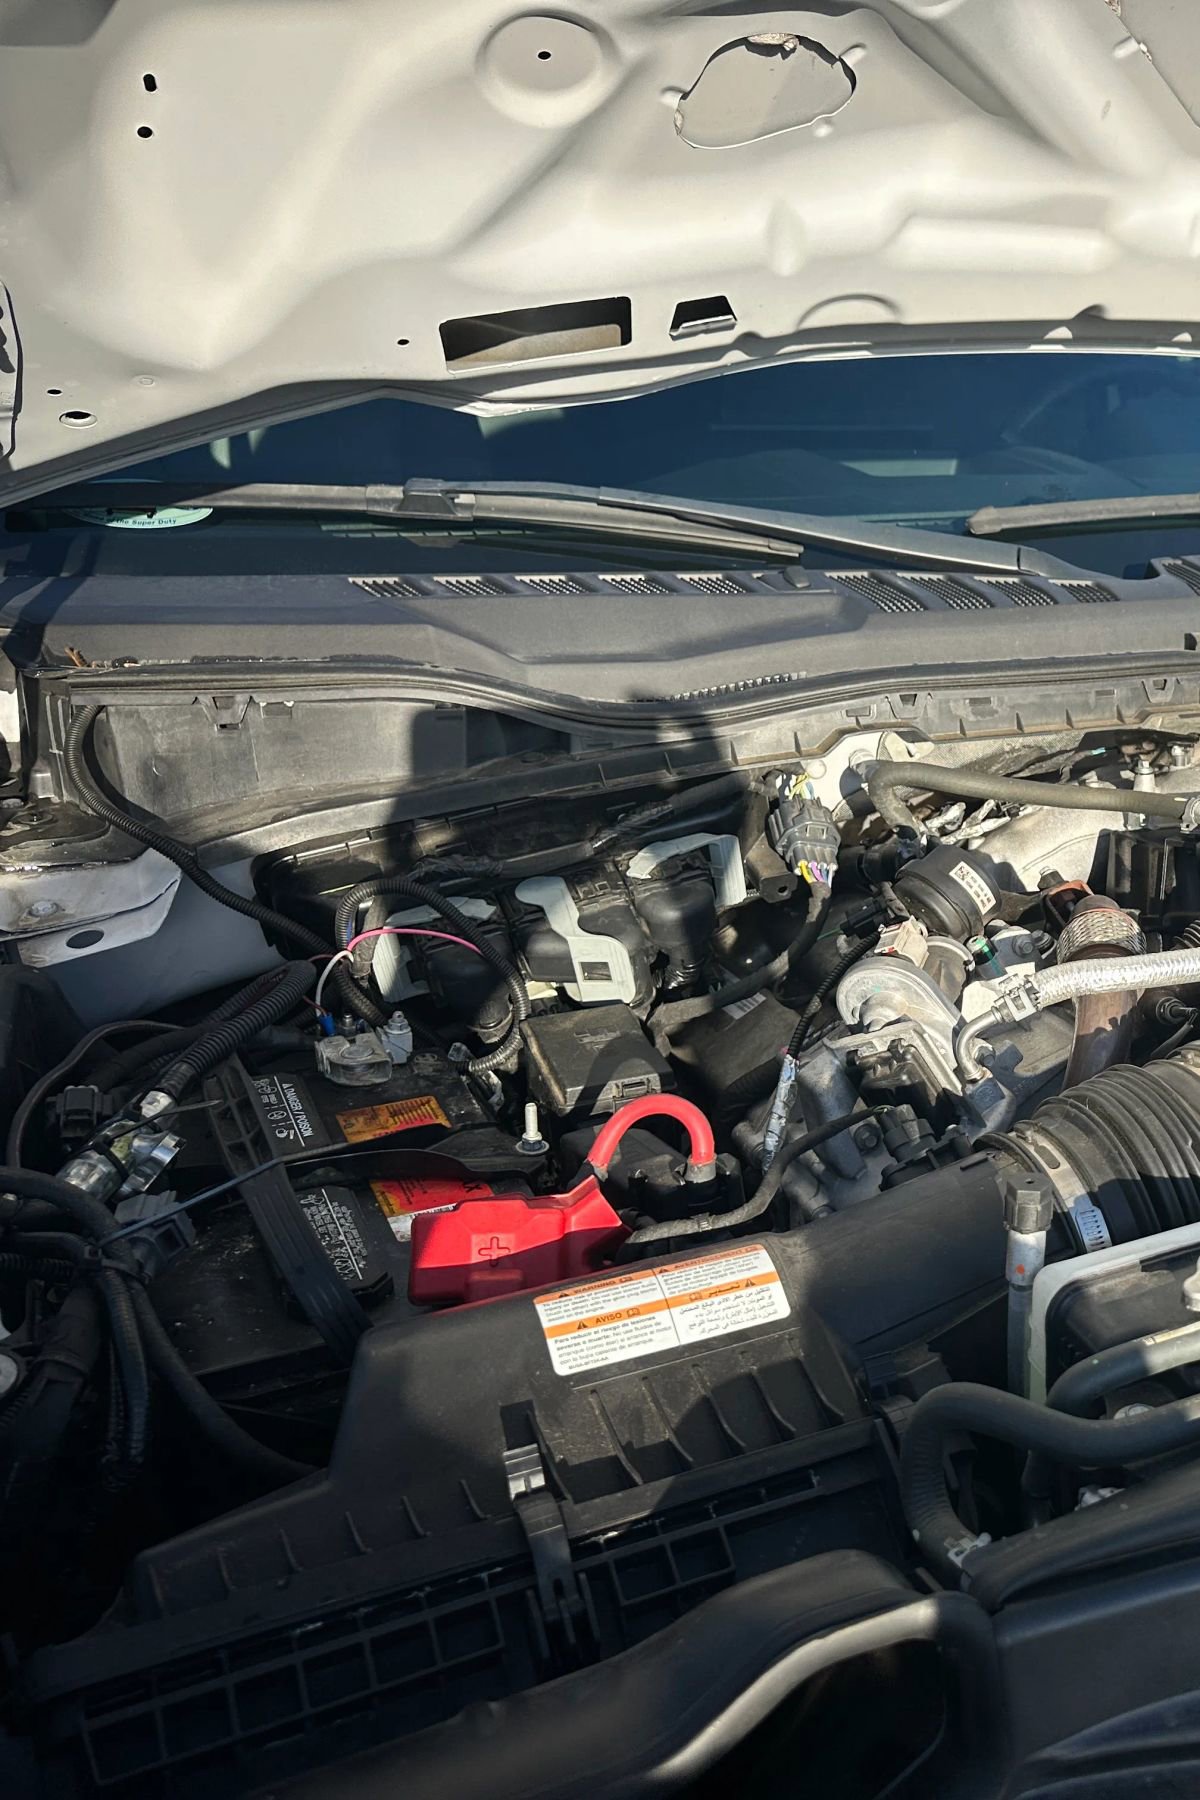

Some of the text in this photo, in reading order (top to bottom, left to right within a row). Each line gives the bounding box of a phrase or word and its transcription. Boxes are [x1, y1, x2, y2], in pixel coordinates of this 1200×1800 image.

[132, 518, 156, 526] Super
[284, 1088, 303, 1112] DANGER
[295, 1114, 314, 1137] POISON
[595, 1312, 622, 1324] AVISO
